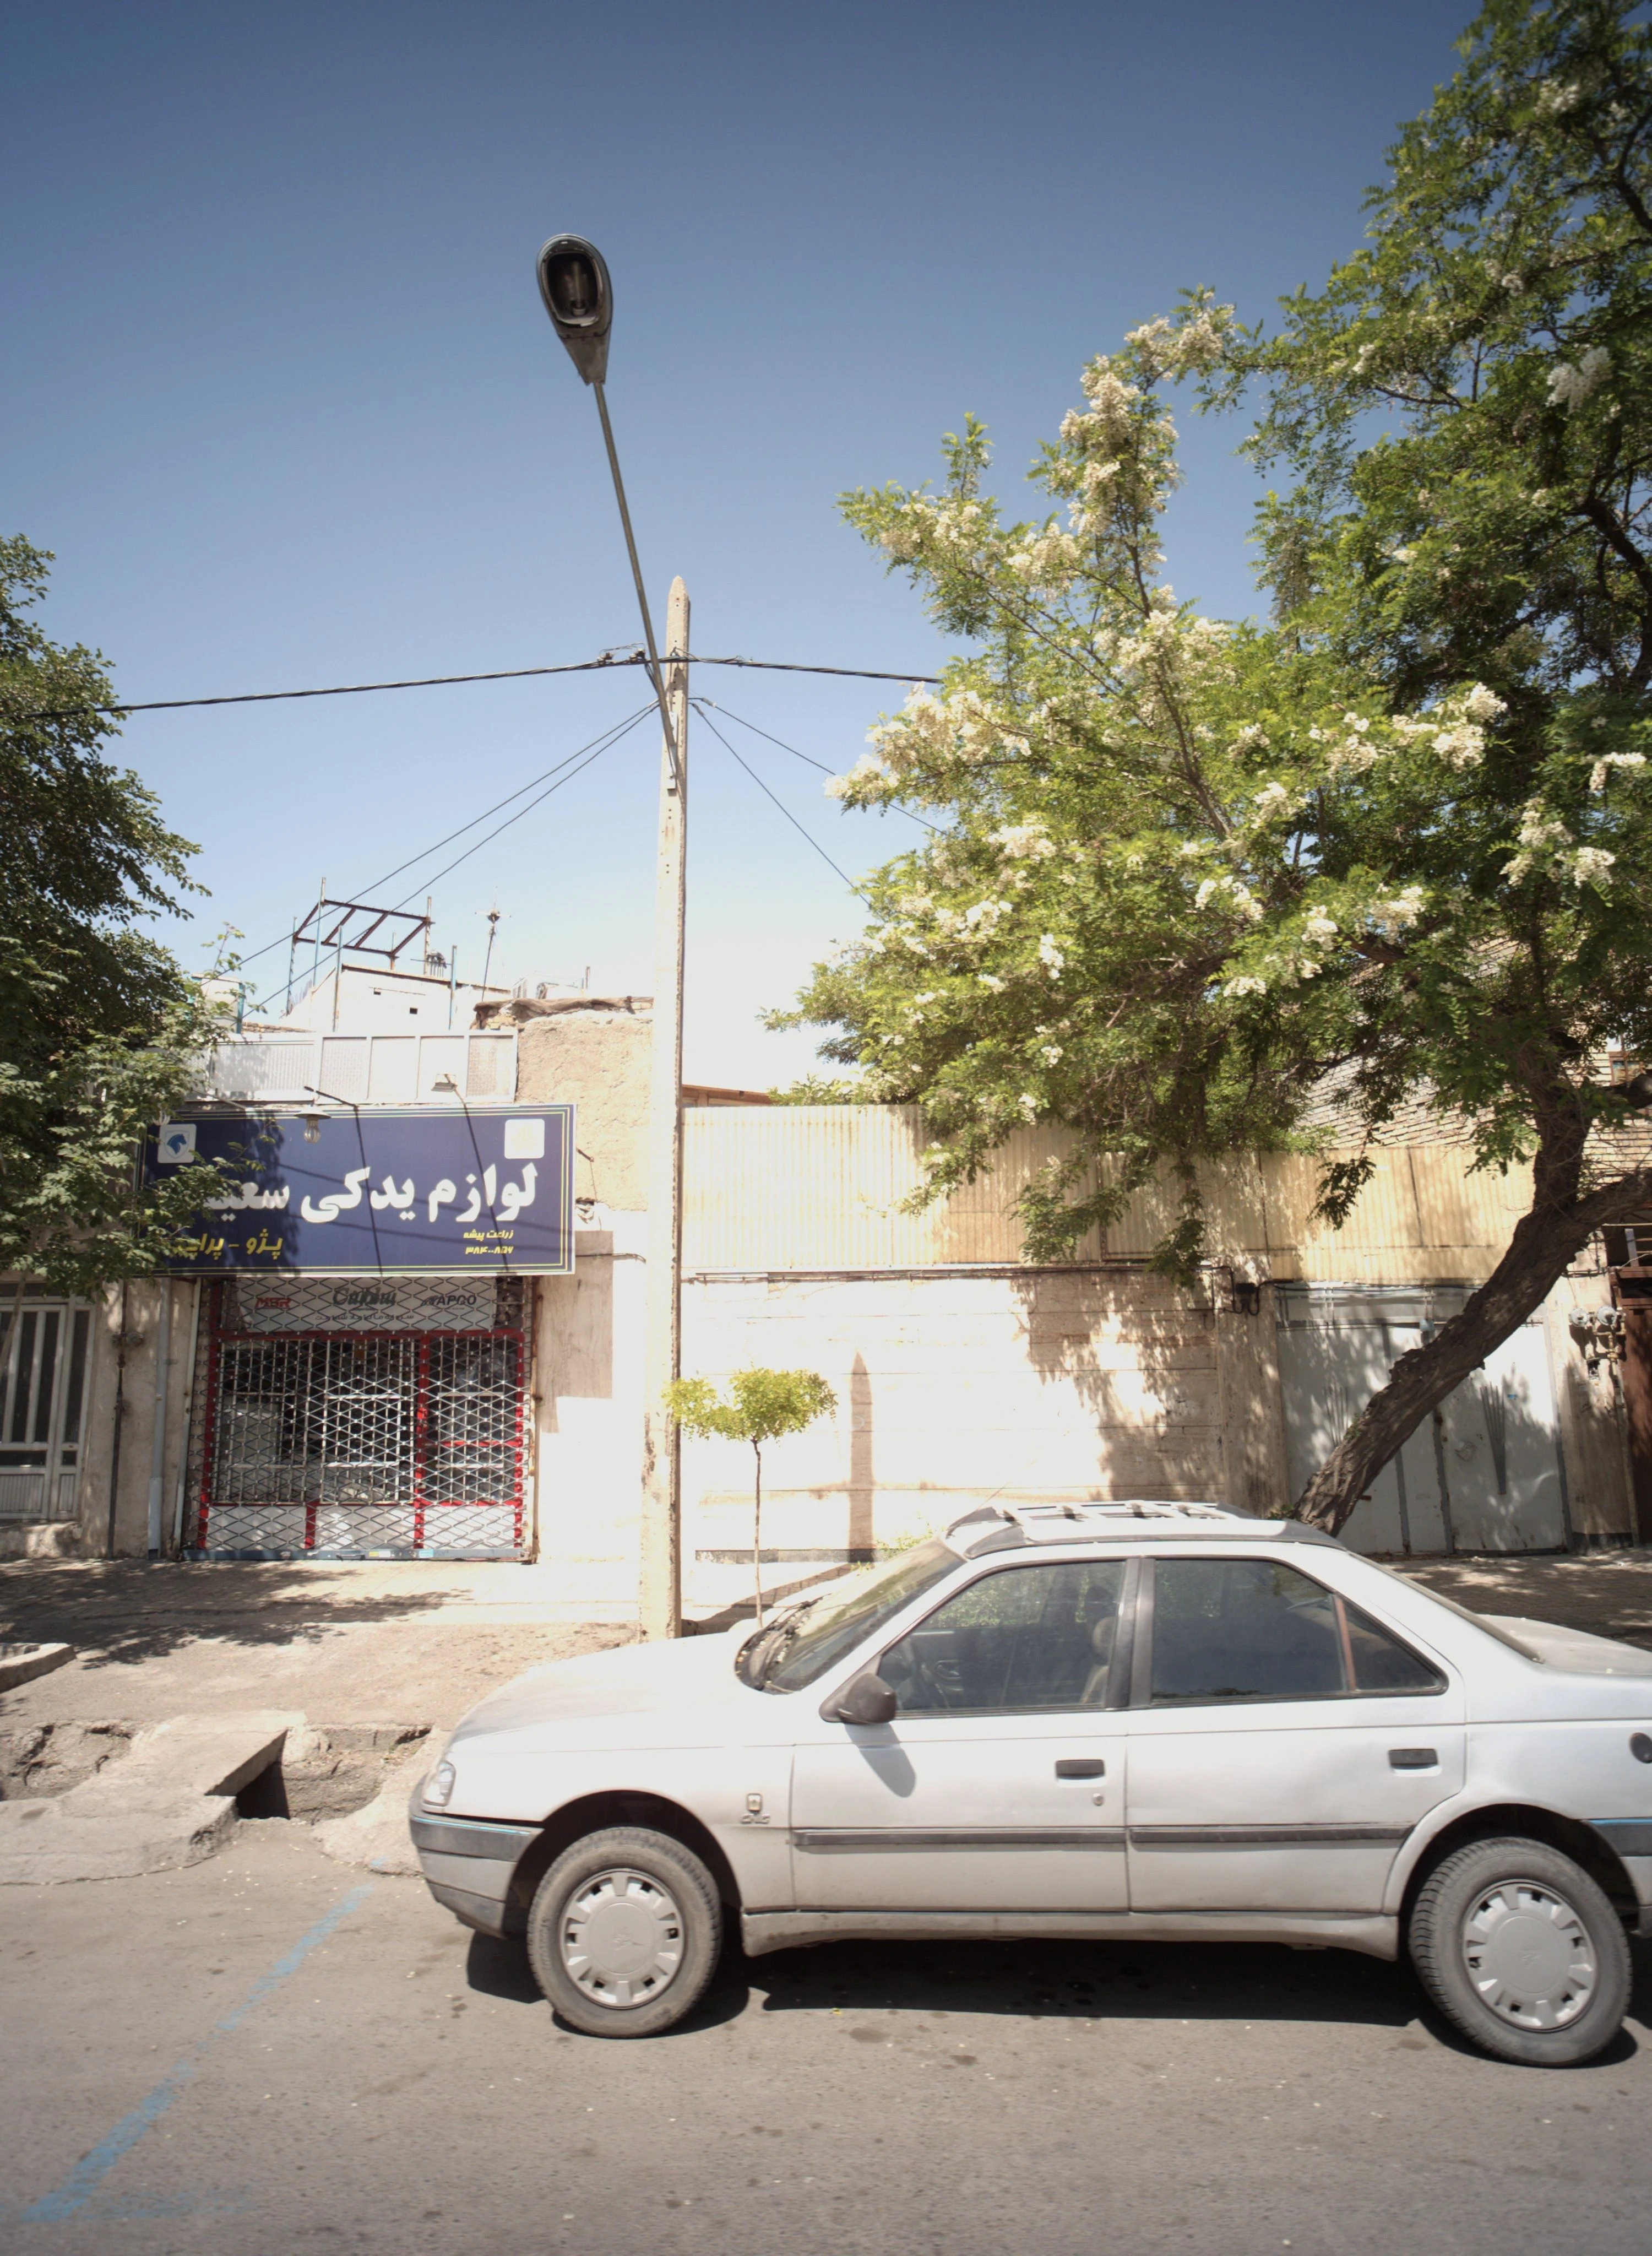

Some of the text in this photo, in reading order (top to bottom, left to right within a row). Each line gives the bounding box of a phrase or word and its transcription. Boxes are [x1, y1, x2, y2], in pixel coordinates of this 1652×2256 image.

[301, 1167, 415, 1223] یدکی
[429, 1162, 539, 1222] لوازم
[246, 1228, 283, 1260] پژو
